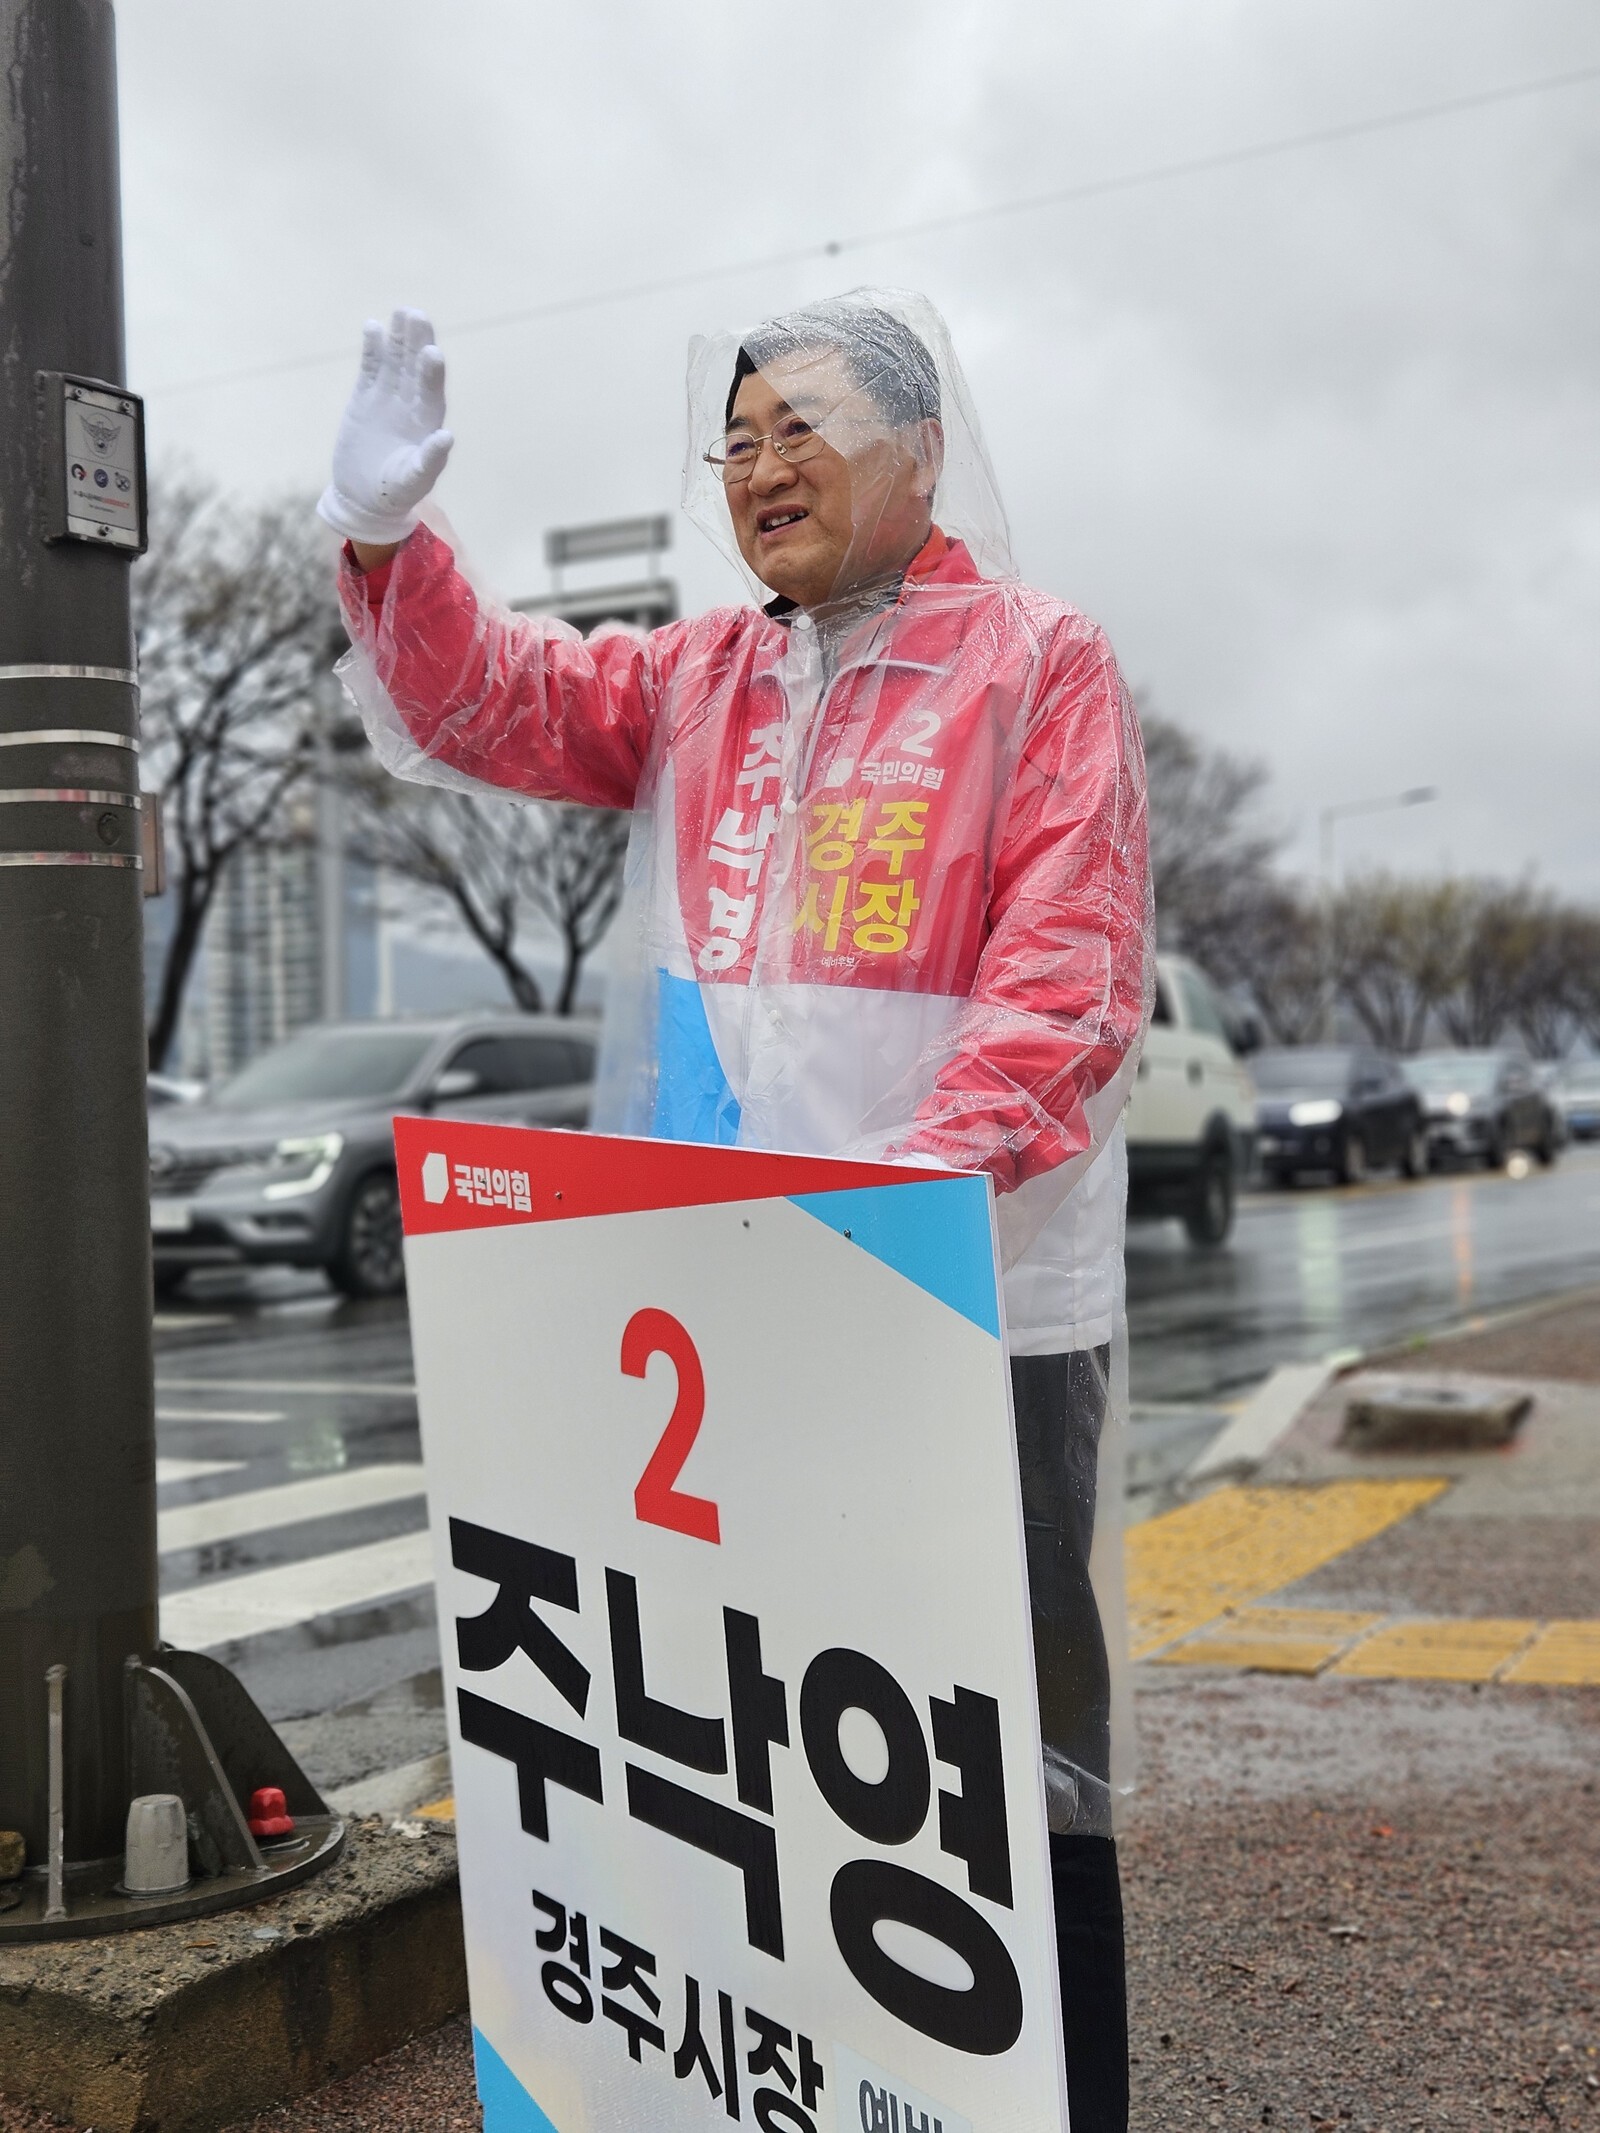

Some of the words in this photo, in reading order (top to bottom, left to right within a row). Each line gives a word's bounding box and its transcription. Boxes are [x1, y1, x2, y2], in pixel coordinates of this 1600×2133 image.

[900, 709, 941, 758] 2
[860, 760, 945, 791] 국민의힘
[806, 798, 930, 876] 경주
[791, 876, 921, 954] 시장
[454, 1163, 533, 1213] 국민의힘
[620, 1306, 721, 1546] 2
[448, 1516, 1024, 2056] 주낙영
[532, 1889, 825, 2133] 경주시장
